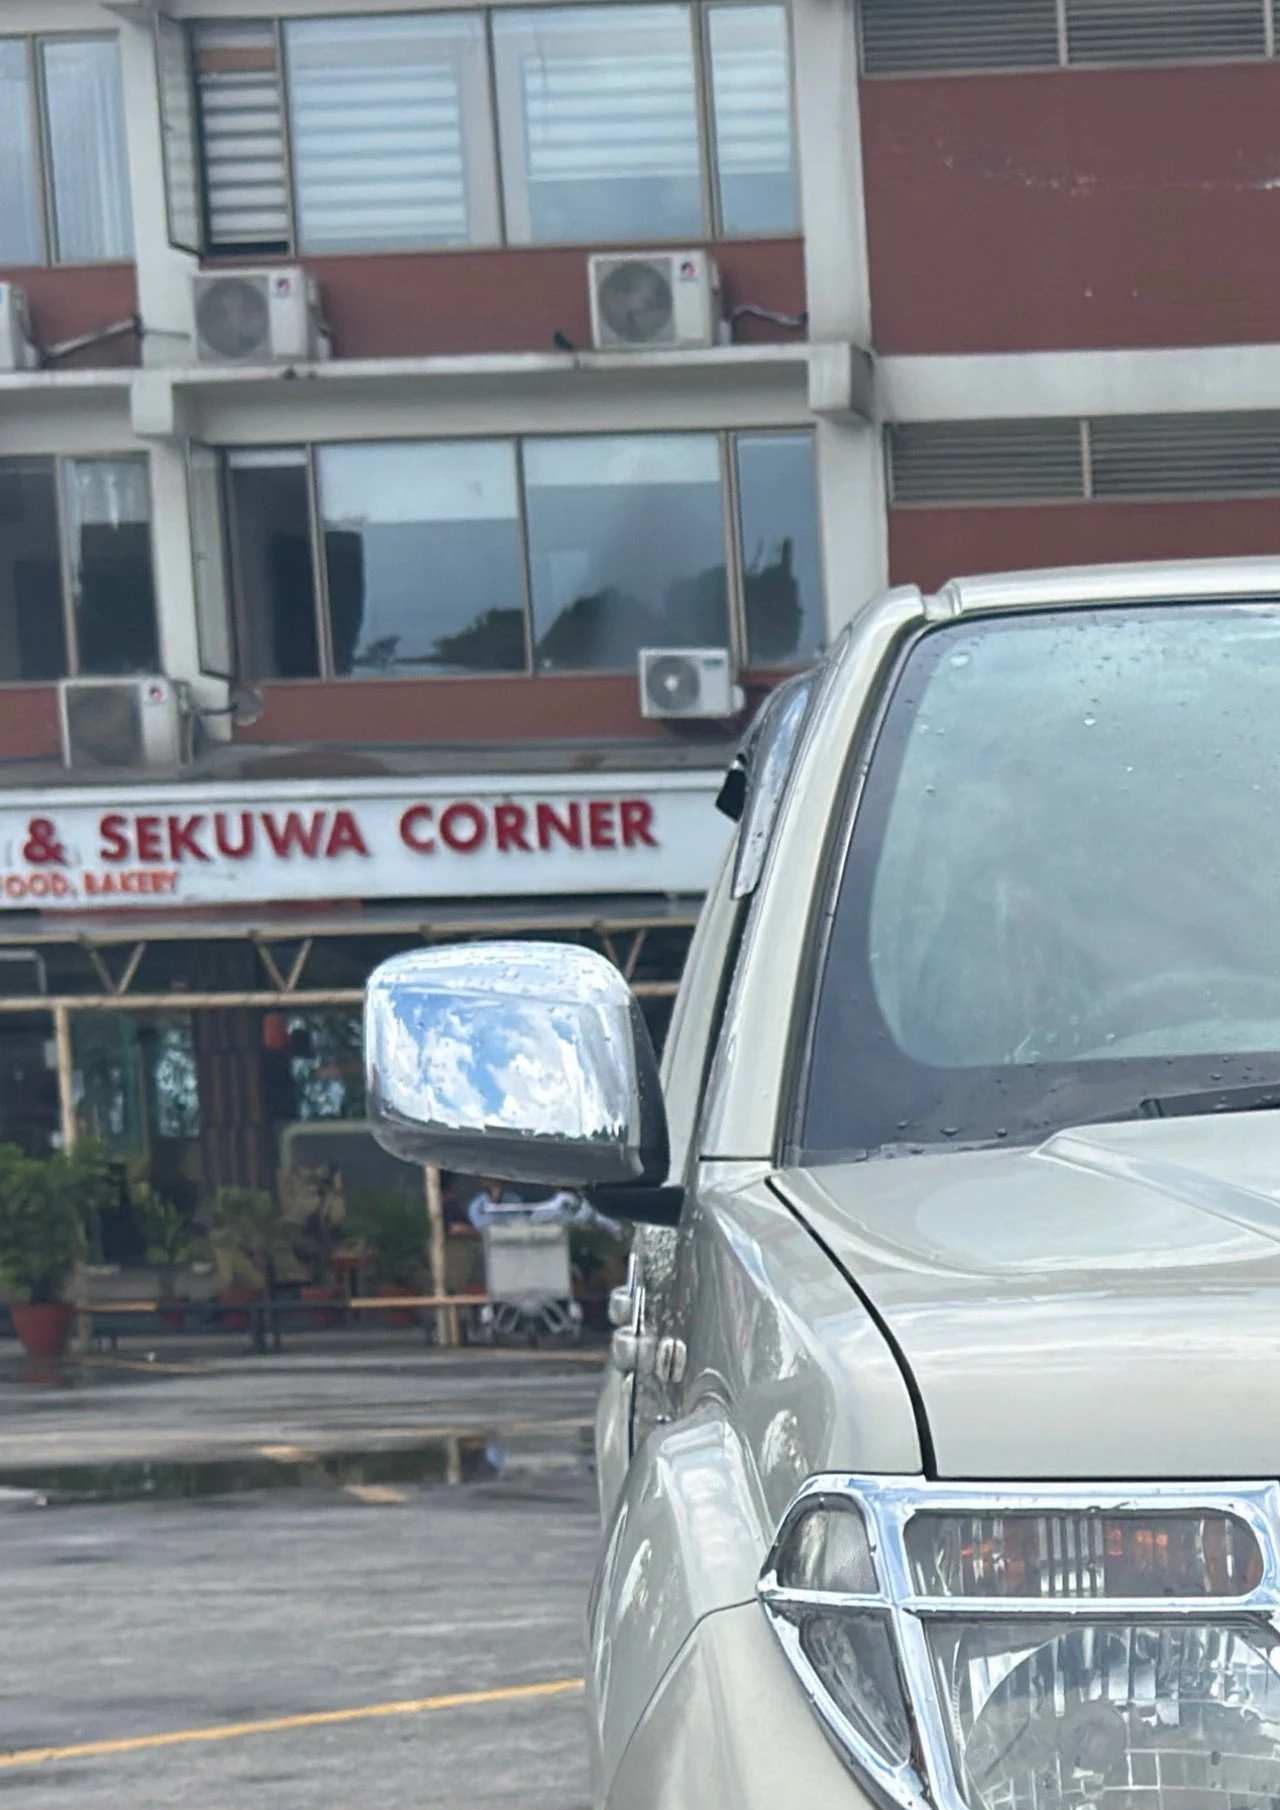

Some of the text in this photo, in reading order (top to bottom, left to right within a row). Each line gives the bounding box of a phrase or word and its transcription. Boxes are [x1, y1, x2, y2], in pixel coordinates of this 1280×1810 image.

[23, 799, 659, 865] & SEKUWA CORNER
